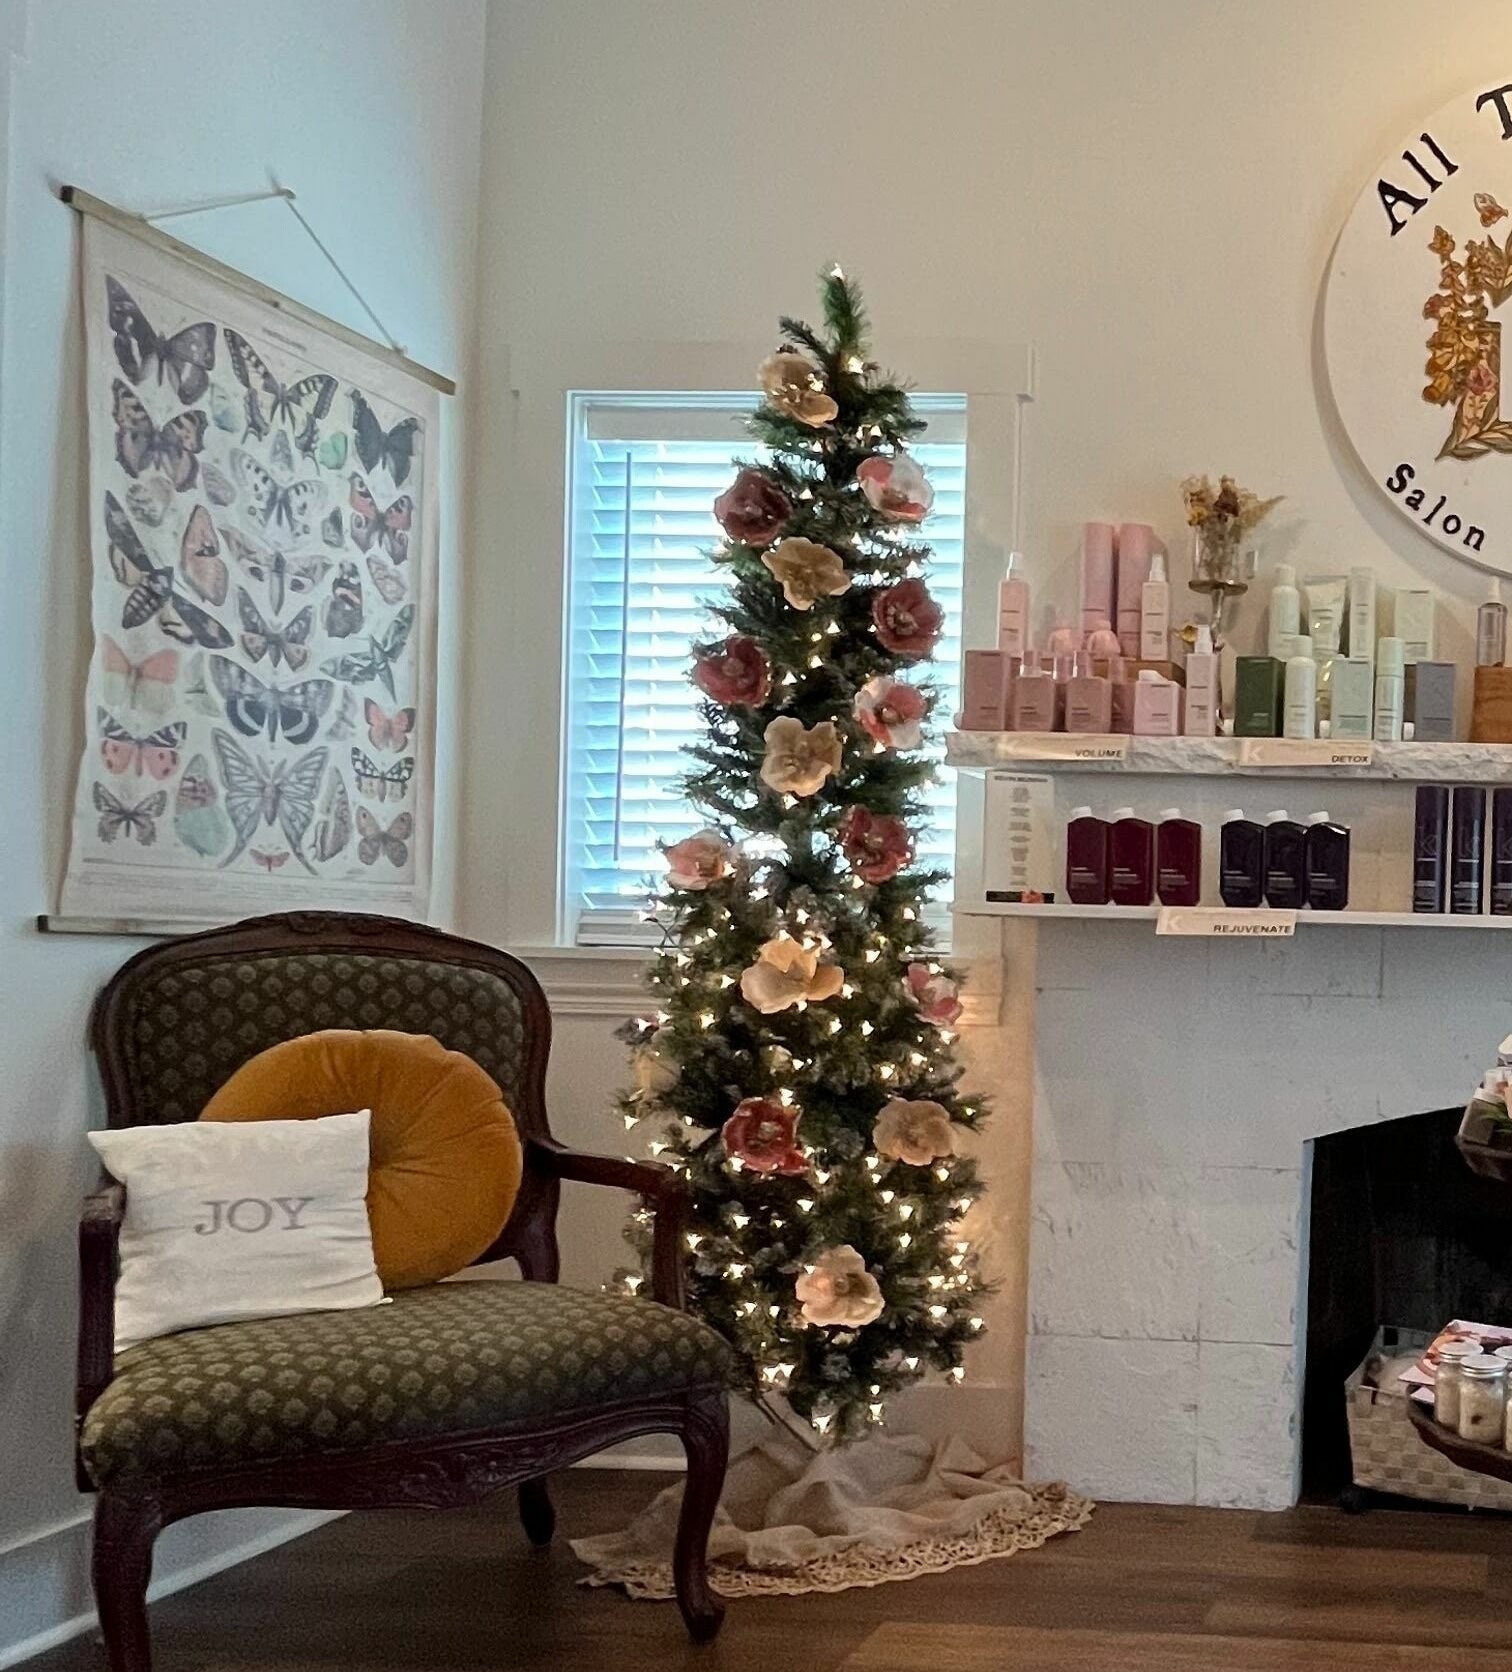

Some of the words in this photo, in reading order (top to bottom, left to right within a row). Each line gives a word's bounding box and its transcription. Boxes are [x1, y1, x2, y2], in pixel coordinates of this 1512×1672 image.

[1376, 132, 1459, 236] All
[1386, 463, 1485, 551] Salon
[1074, 749, 1123, 758] VOLUME
[1331, 755, 1369, 764] DETOX
[1213, 924, 1292, 934] REJUVENATE
[194, 1197, 315, 1237] JOY
